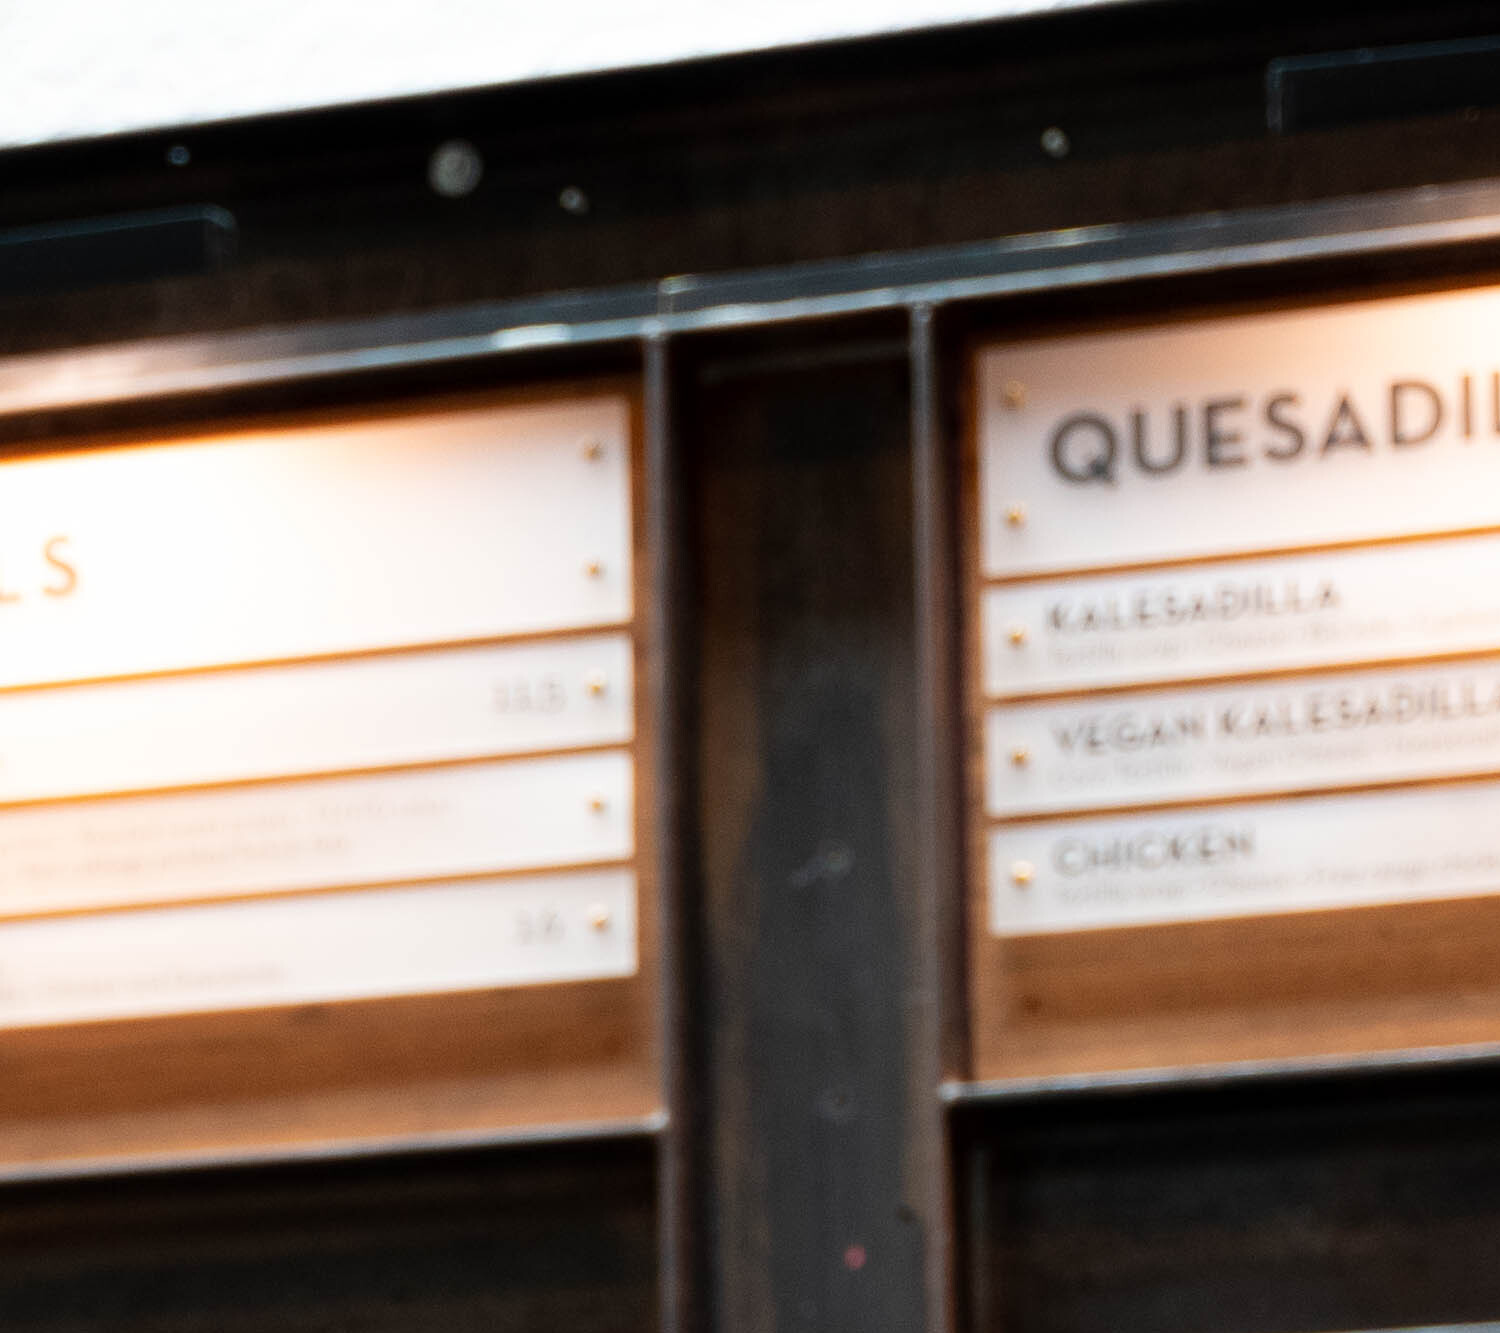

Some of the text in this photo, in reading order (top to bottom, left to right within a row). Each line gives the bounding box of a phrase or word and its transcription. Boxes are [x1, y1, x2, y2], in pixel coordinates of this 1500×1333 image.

[1044, 576, 1341, 638] KALESADILLA
[1053, 705, 1204, 757] VEGAN
[1053, 827, 1256, 878] CHICKEN
